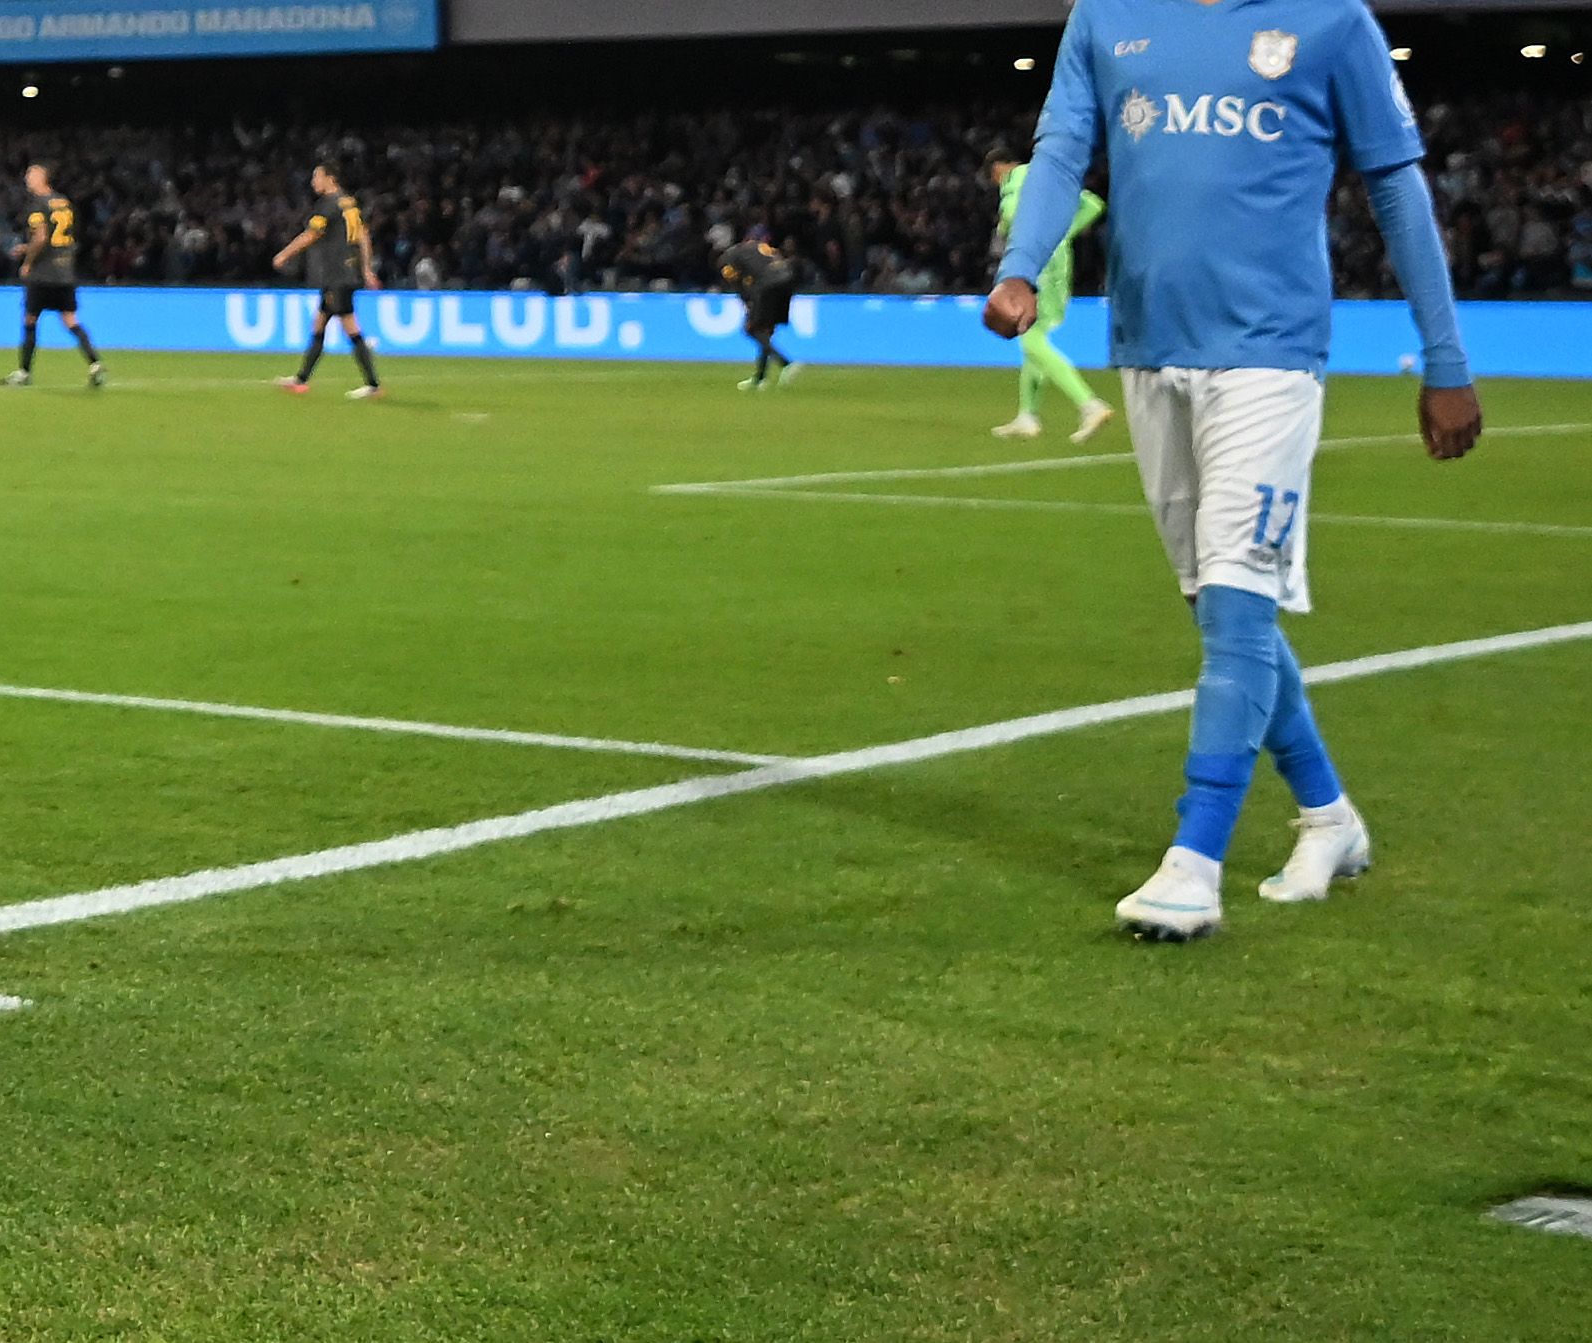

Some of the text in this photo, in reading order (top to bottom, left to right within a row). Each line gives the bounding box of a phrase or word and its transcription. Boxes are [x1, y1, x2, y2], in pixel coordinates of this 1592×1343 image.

[38, 9, 190, 40] ARMANDO
[194, 3, 376, 33] MARADONA
[1163, 93, 1287, 142] MSC
